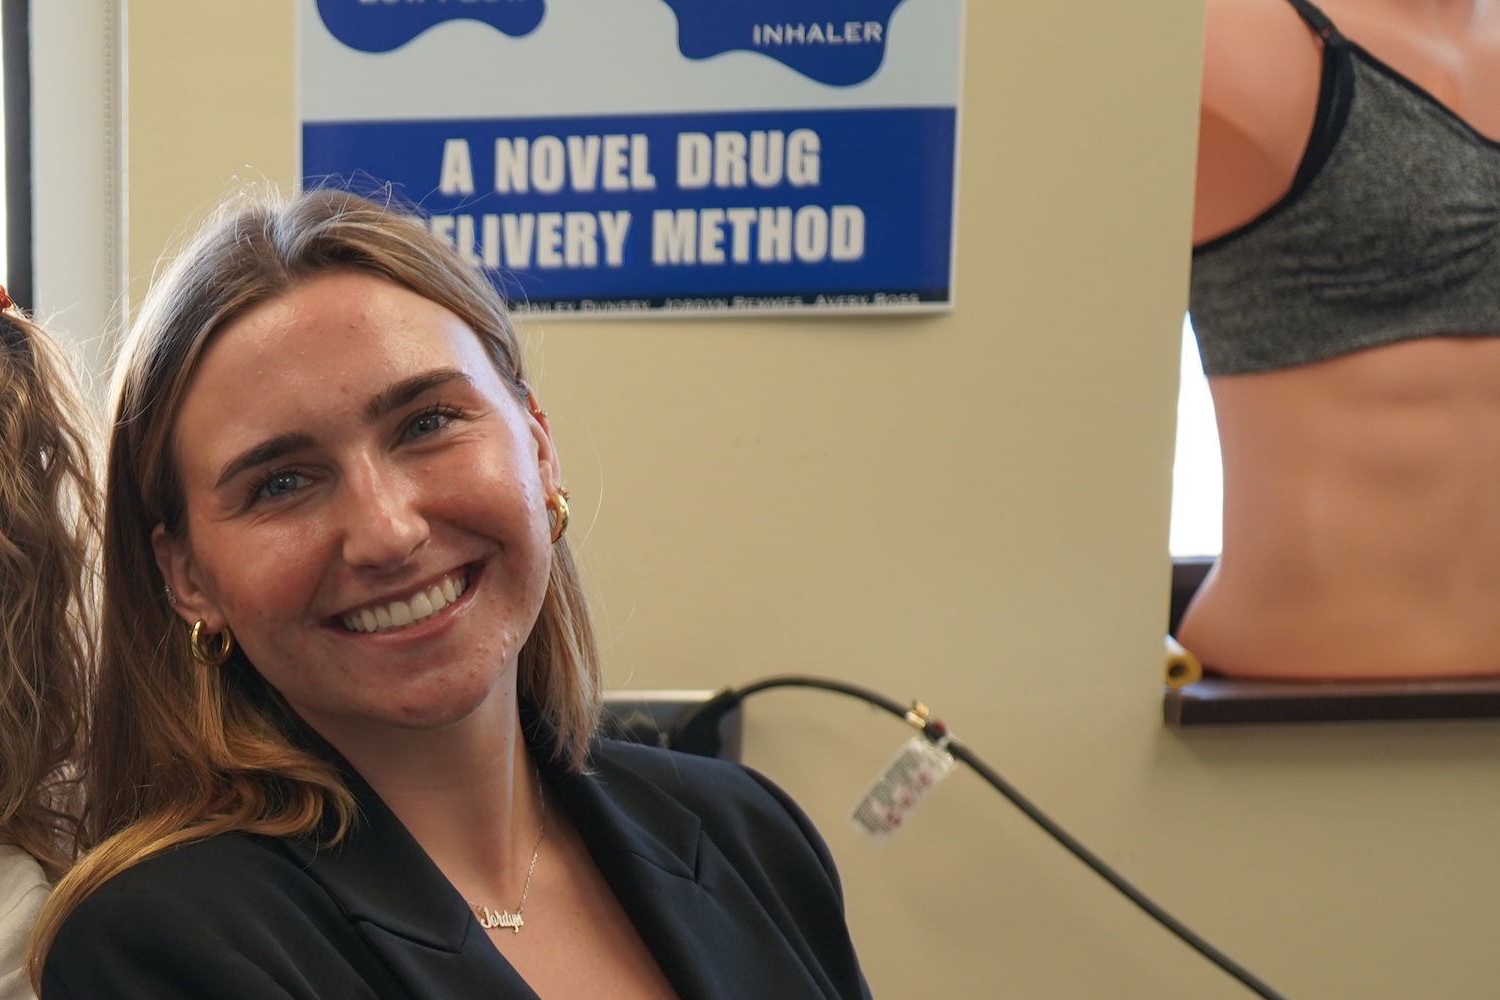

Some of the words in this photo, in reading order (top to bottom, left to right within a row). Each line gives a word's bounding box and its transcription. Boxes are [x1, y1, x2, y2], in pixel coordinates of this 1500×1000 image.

[753, 21, 883, 46] INHALER
[440, 138, 474, 194] A
[495, 134, 656, 194] NOVEL
[677, 129, 821, 188] DRUG
[422, 210, 632, 269] ELIVERY
[652, 204, 866, 265] METHOD
[814, 294, 869, 309] AVERY
[873, 292, 920, 308] ROSS
[480, 906, 525, 933] Jordyn
